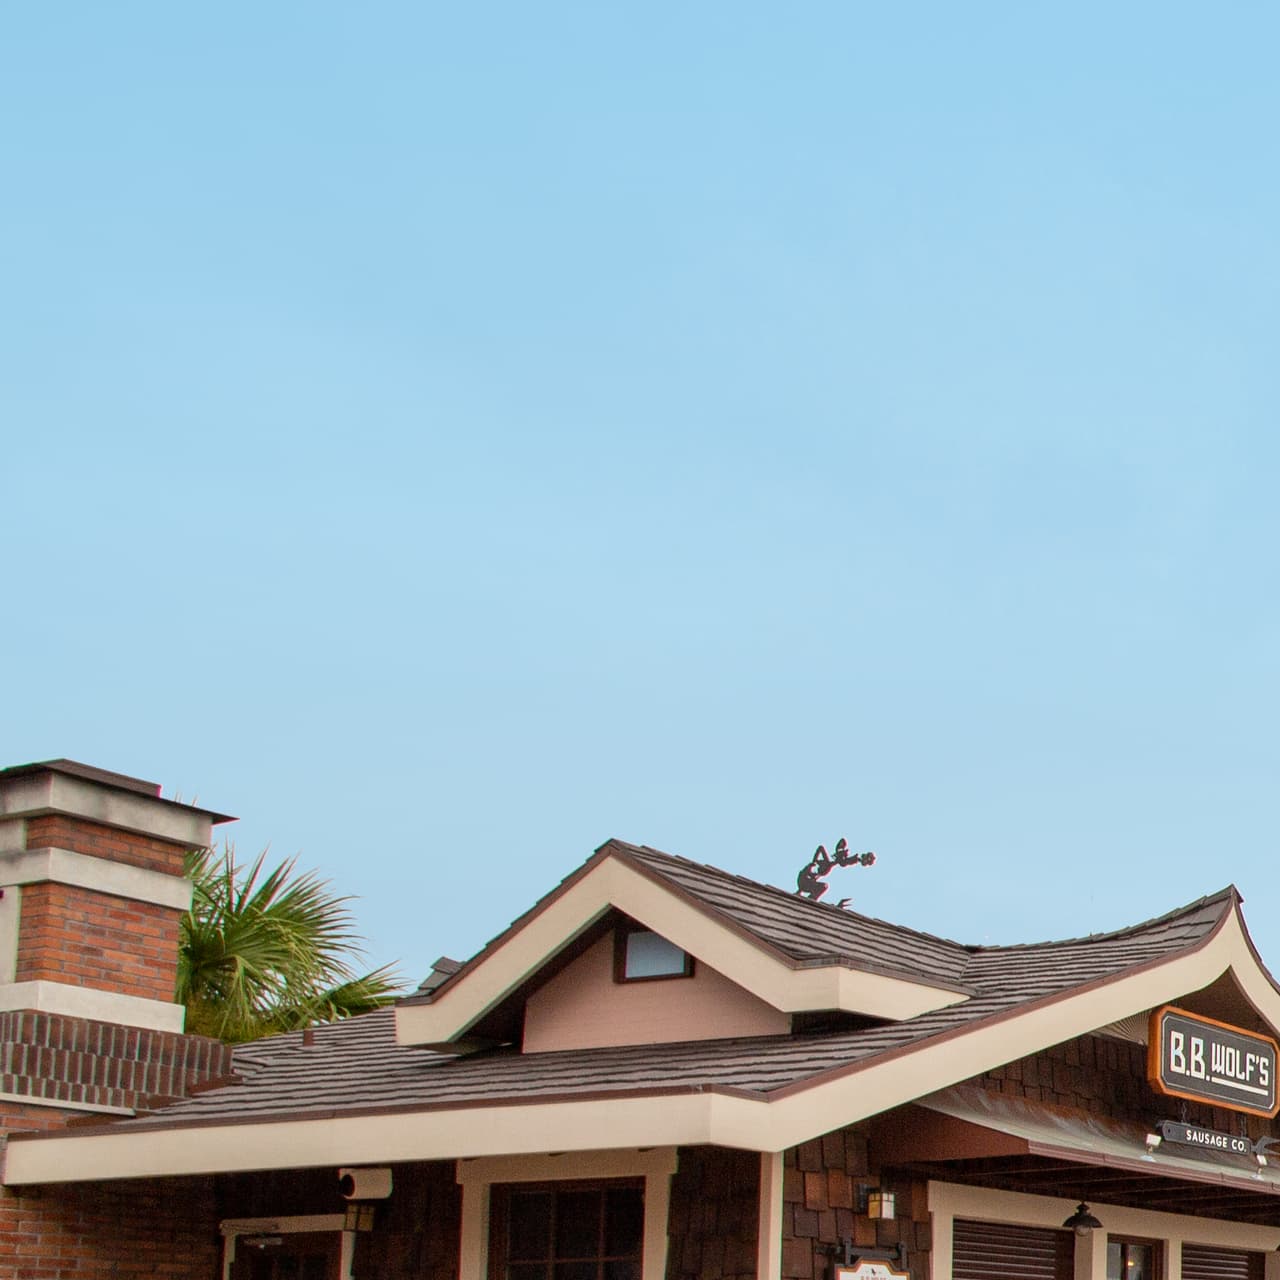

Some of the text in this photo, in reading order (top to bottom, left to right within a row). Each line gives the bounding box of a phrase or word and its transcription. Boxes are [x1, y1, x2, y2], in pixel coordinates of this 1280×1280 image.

[1170, 1030, 1269, 1087] B.B. WOLF'S
[1185, 1130, 1247, 1153] SAUSAGE CO.
